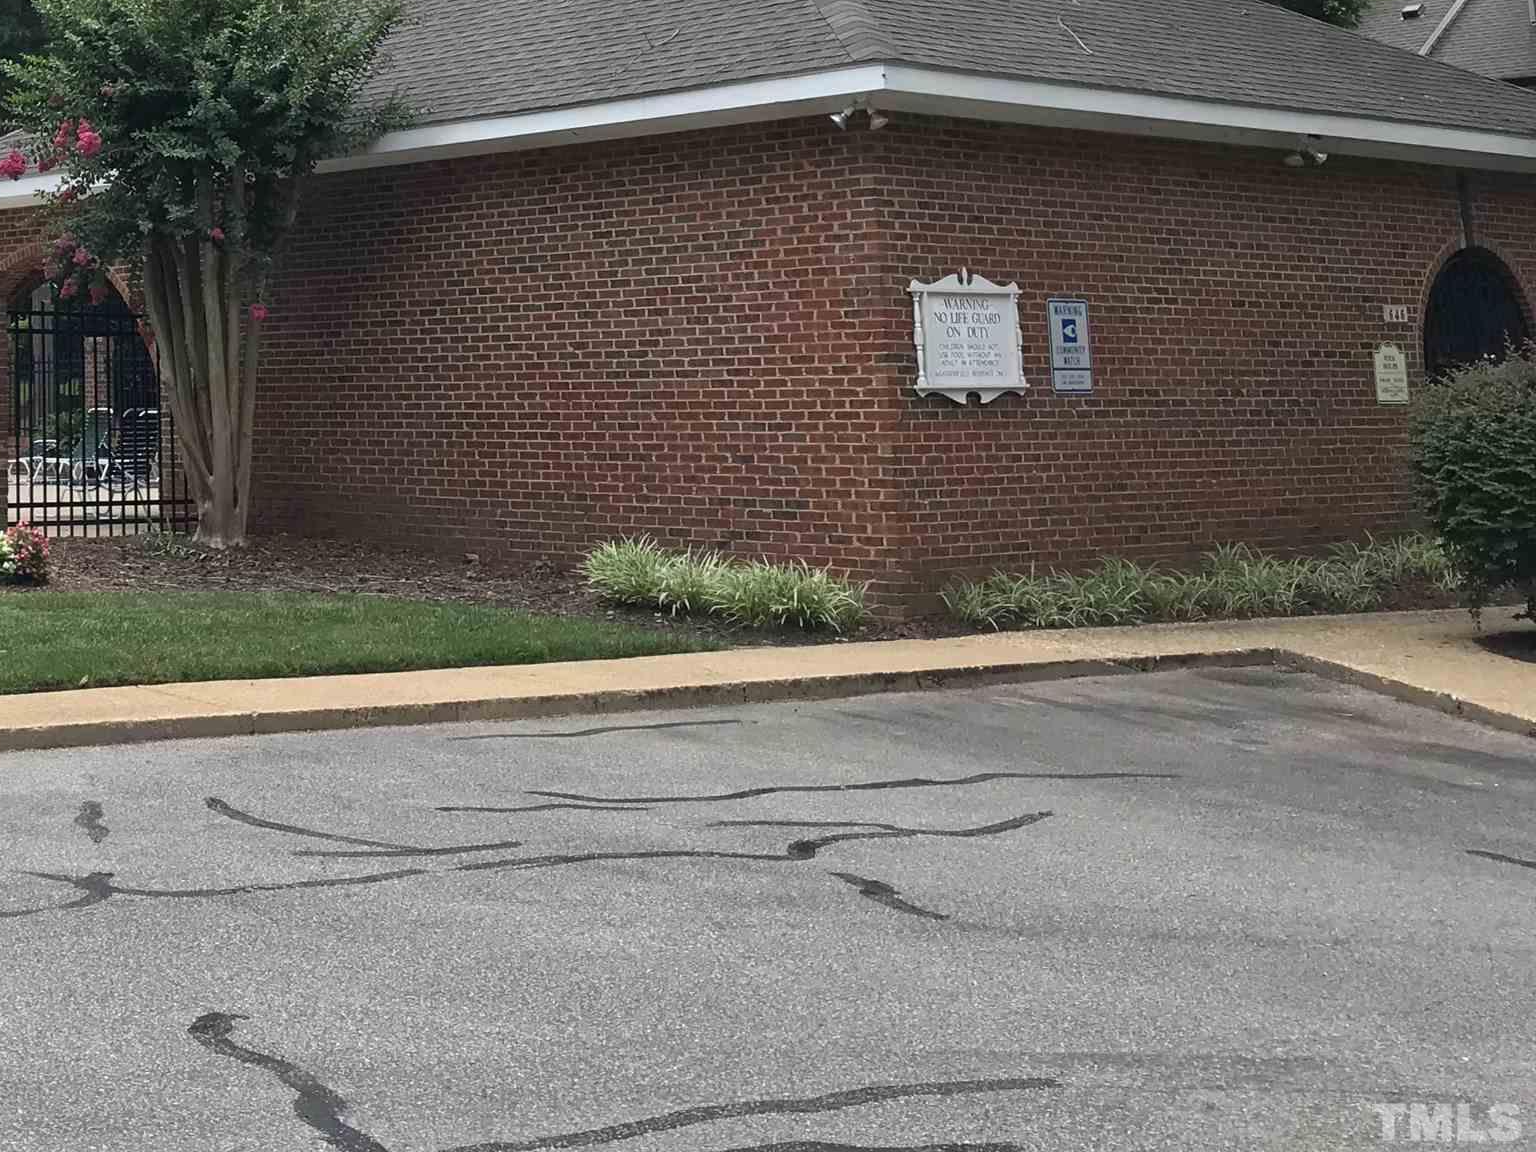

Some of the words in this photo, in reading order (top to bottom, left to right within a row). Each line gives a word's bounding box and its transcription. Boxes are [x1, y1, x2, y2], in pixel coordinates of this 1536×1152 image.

[934, 312, 948, 323] NO
[950, 312, 967, 324] LIFE
[971, 312, 1001, 324] GUARD
[946, 326, 961, 338] ON
[967, 326, 990, 338] DUTY
